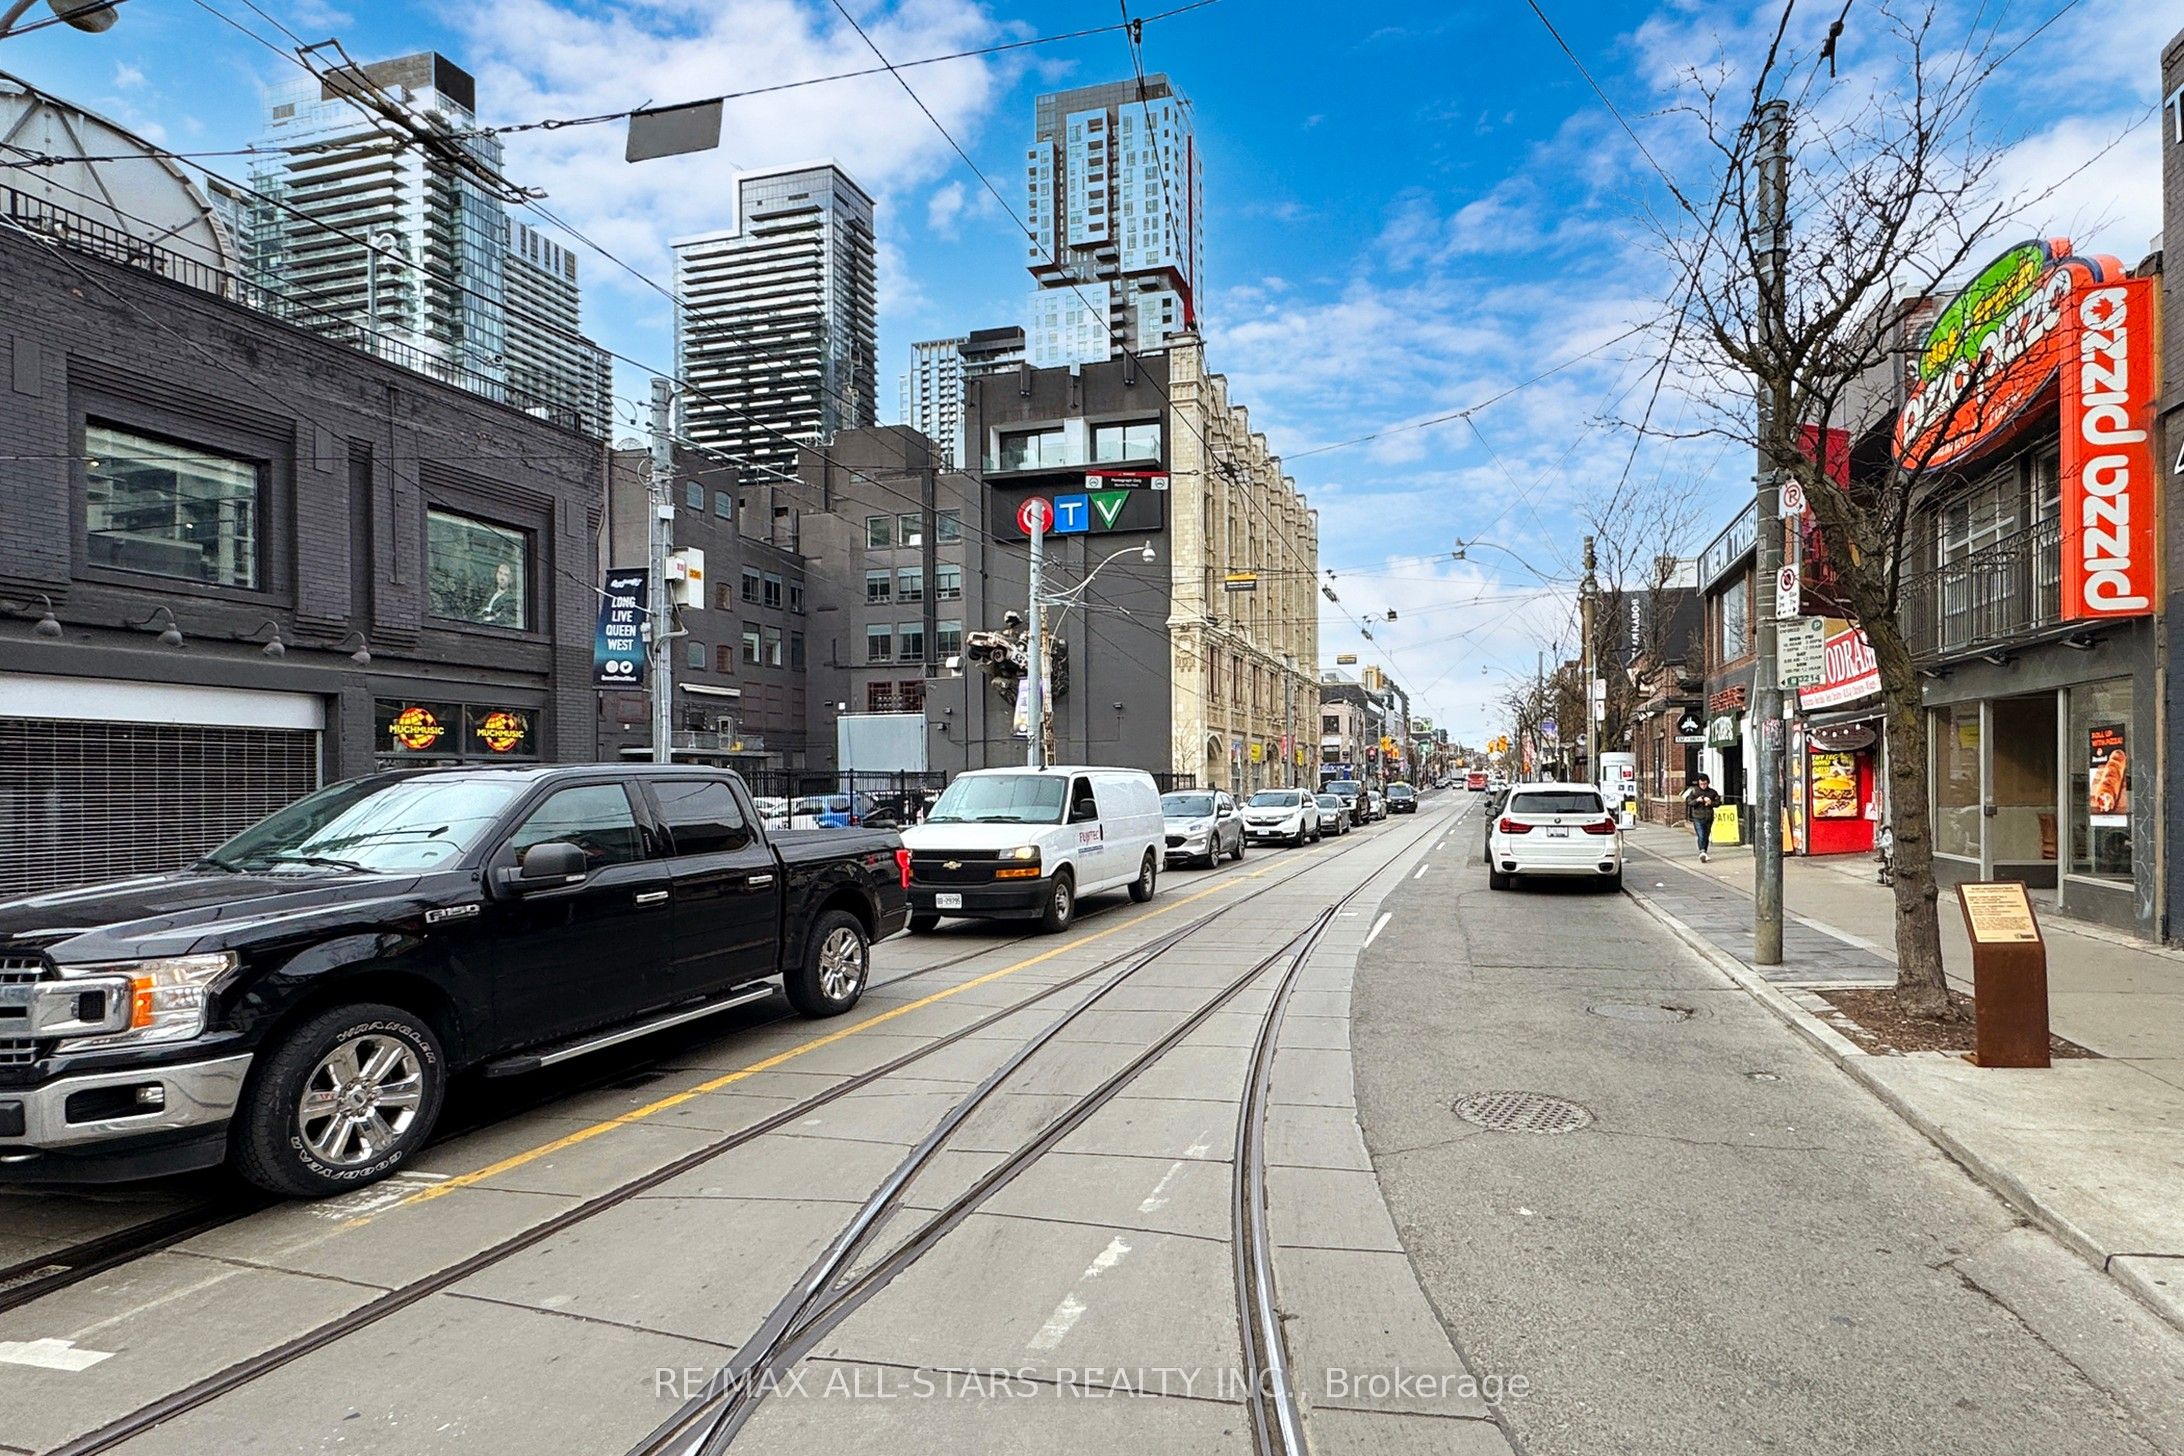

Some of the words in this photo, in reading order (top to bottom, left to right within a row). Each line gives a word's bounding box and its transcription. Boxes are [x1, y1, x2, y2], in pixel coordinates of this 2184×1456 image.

[2079, 287, 2147, 445] pizza
[2082, 454, 2149, 611] pizza
[611, 595, 636, 608] LONG
[611, 610, 633, 622] LIVE
[606, 624, 636, 637] QUEEN
[607, 638, 634, 651] WEST
[389, 724, 445, 735] MUCHMUSIC
[477, 729, 525, 738] MUCHMUSIC
[335, 1020, 437, 1064] WRANGLER
[290, 1136, 402, 1180] GOODYEAR
